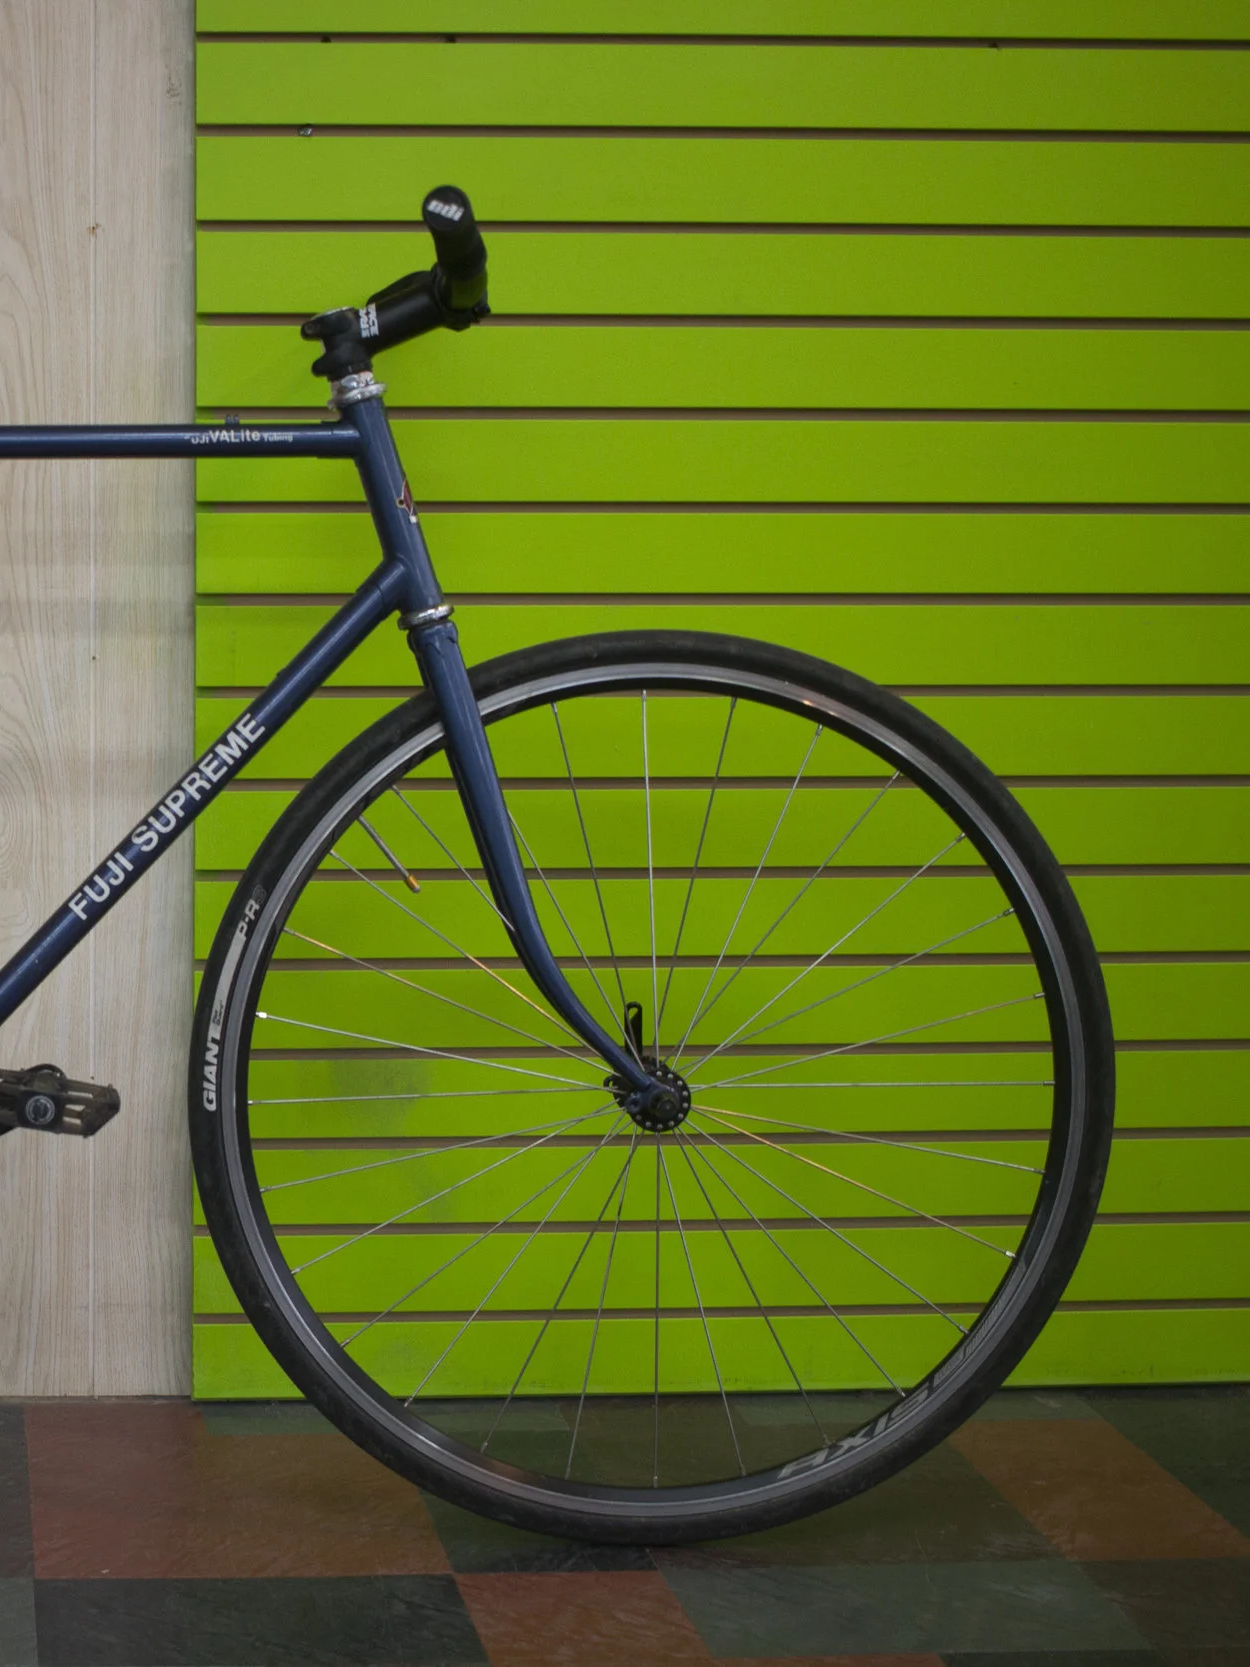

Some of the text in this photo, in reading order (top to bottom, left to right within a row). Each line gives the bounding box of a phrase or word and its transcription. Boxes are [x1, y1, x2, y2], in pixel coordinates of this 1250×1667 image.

[68, 712, 266, 921] FUJI SUPREME
[203, 1033, 222, 1112] GIANT
